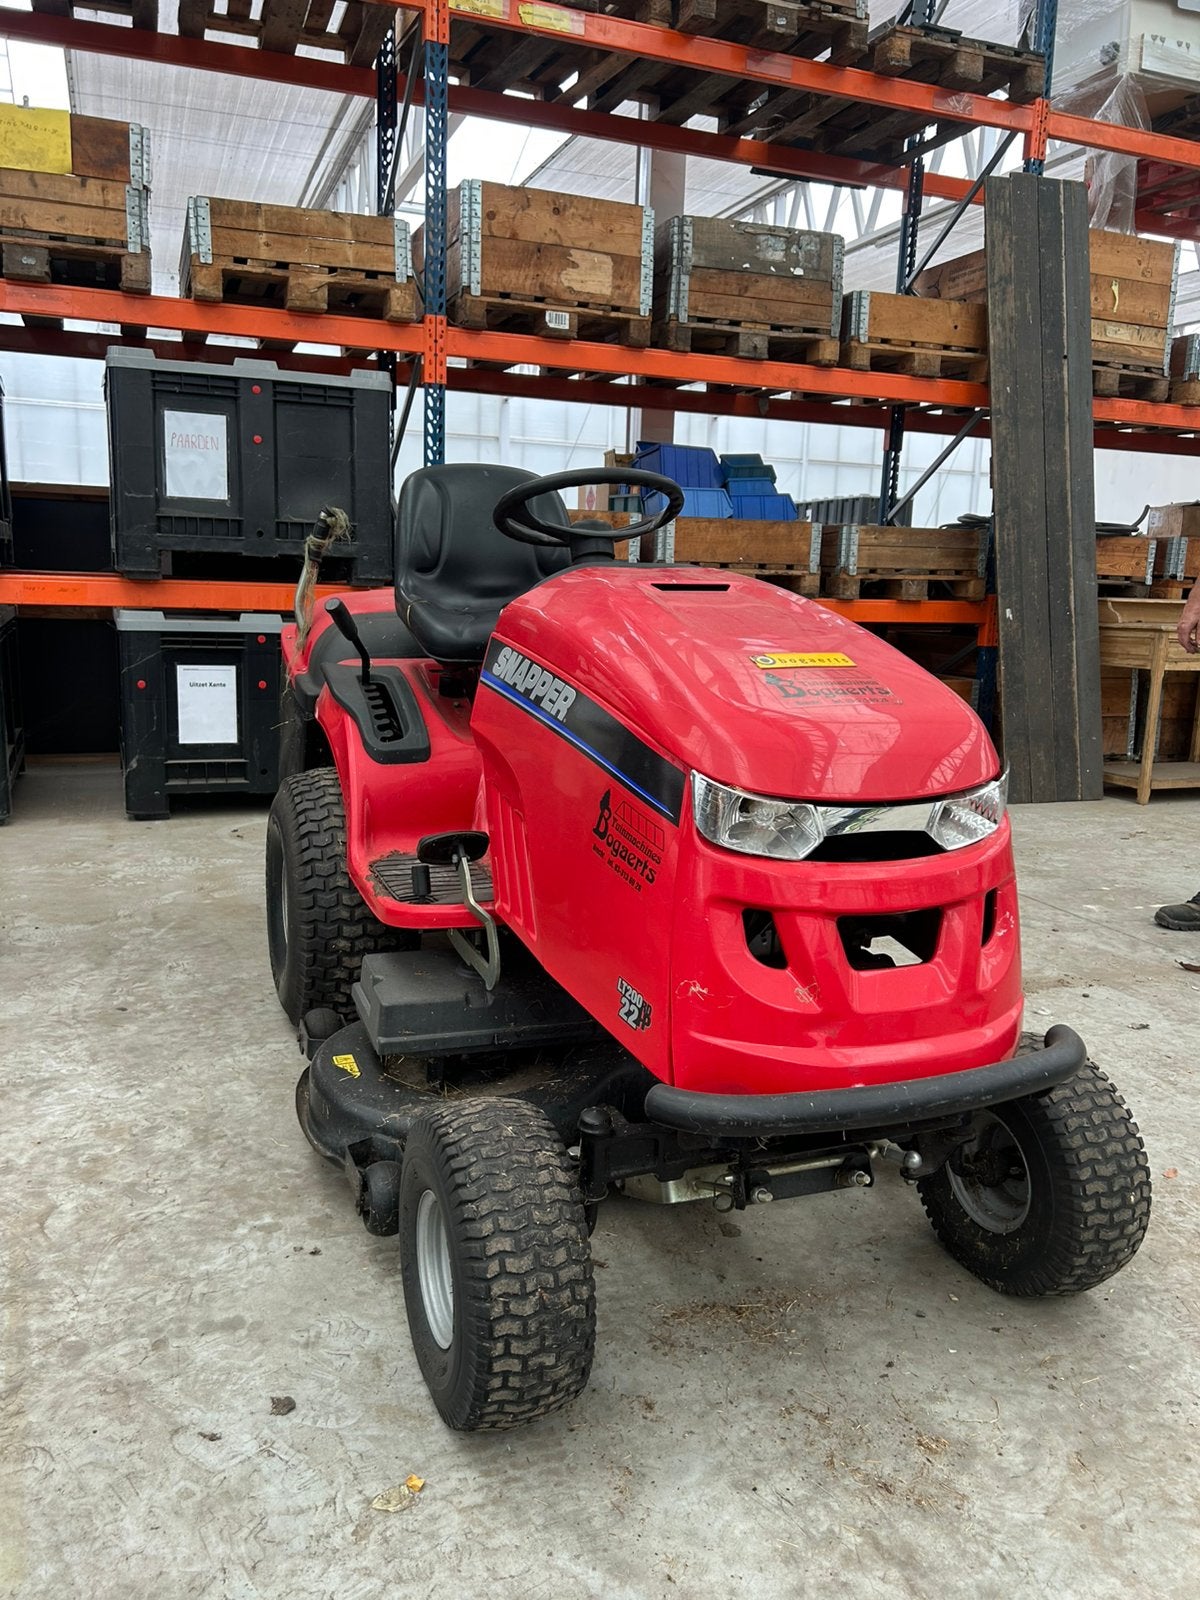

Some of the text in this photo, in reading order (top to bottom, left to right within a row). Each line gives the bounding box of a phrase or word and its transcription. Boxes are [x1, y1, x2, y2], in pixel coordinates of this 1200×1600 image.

[170, 432, 219, 450] PAARDEN
[777, 657, 850, 665] bogaerts
[492, 646, 577, 722] SNAPPER
[765, 672, 891, 699] Bogaerts
[592, 792, 657, 884] Bogaerts
[611, 814, 662, 865] Tuinmachines
